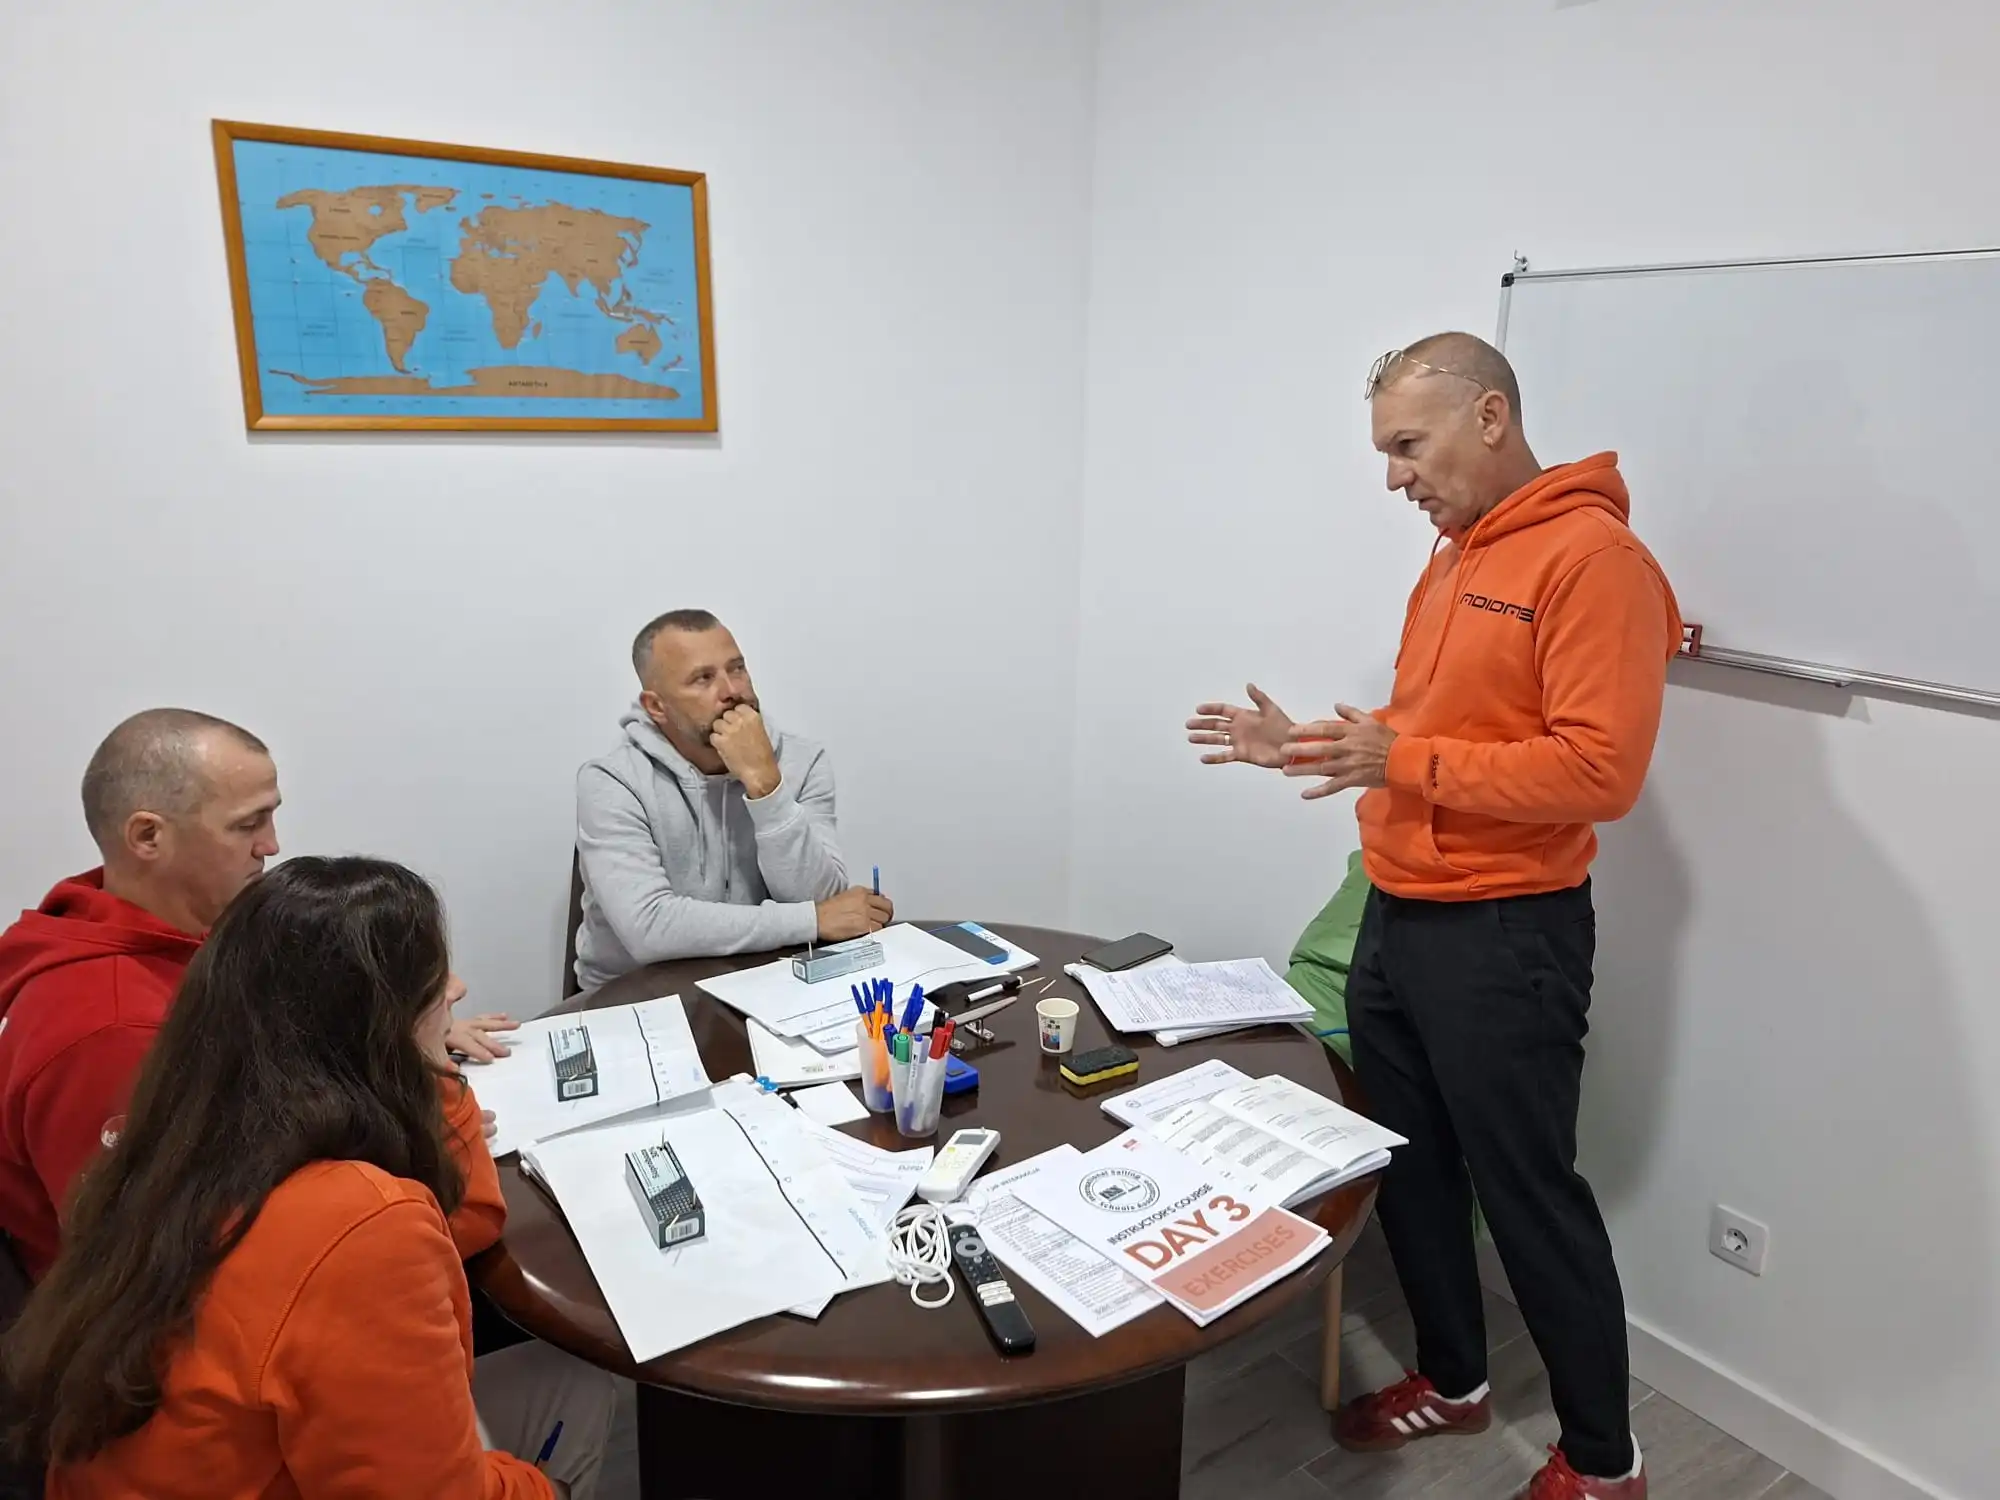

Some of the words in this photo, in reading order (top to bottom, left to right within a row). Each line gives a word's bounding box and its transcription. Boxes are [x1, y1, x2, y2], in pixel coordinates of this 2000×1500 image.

[1123, 1209, 1220, 1270] DAY
[1208, 1195, 1250, 1222] 3
[1174, 1183, 1214, 1213] COURSE
[1182, 1225, 1296, 1298] EXERCISES
